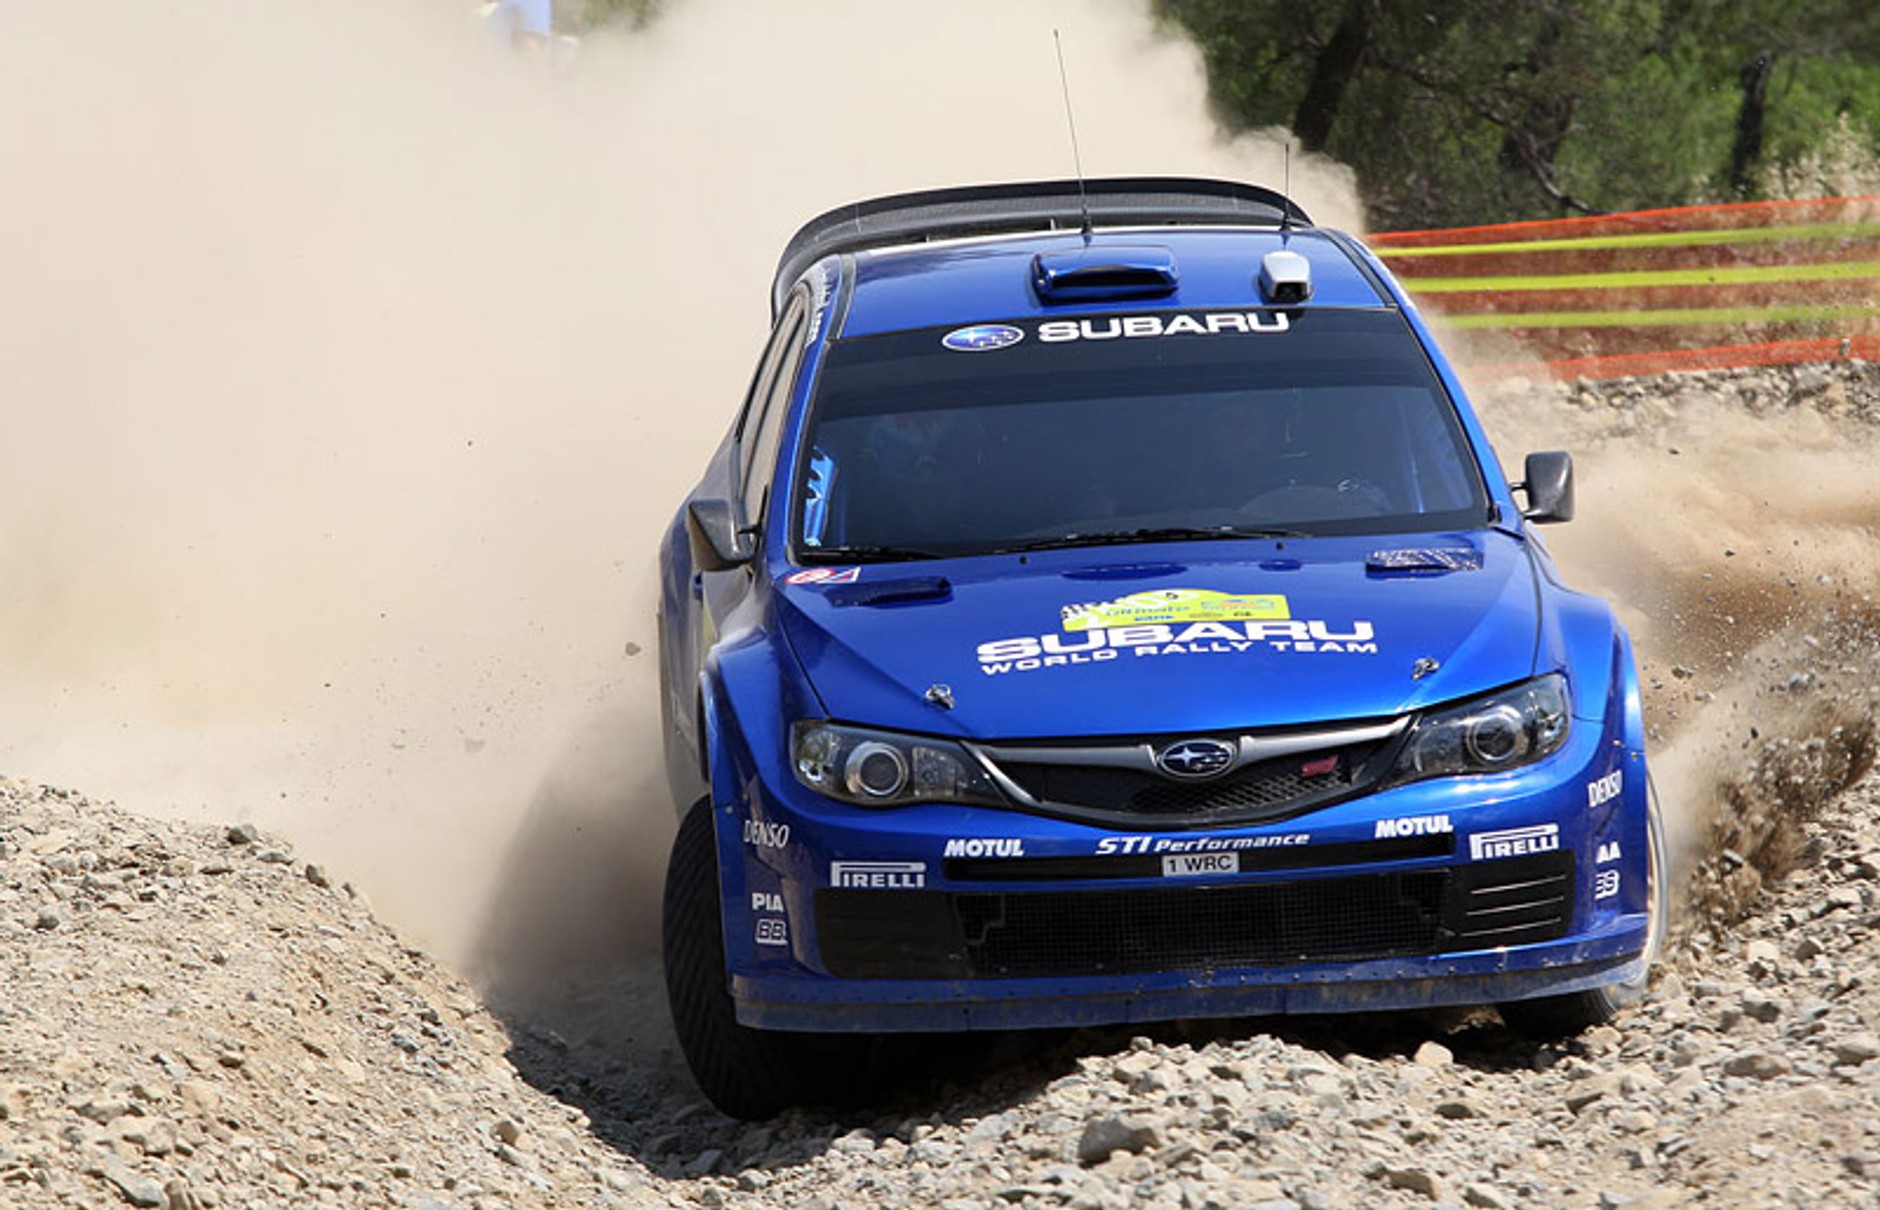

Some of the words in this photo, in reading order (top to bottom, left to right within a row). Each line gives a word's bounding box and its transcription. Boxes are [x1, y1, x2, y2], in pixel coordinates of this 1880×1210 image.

[1038, 312, 1290, 343] SUBARU
[976, 619, 1374, 663] SUBARU
[982, 648, 1118, 676] WORLD
[1134, 640, 1254, 657] RALLY
[1269, 640, 1378, 655] TEAM
[743, 819, 790, 849] DENSO
[1375, 814, 1454, 839] MOTUL
[944, 838, 1024, 858] MOTUL
[1095, 835, 1153, 855] STI
[1153, 834, 1311, 852] Performance
[1469, 823, 1559, 861] PIRELLI
[830, 861, 927, 888] PIRELLI
[1167, 859, 1177, 873] 1
[1184, 854, 1232, 872] WRC
